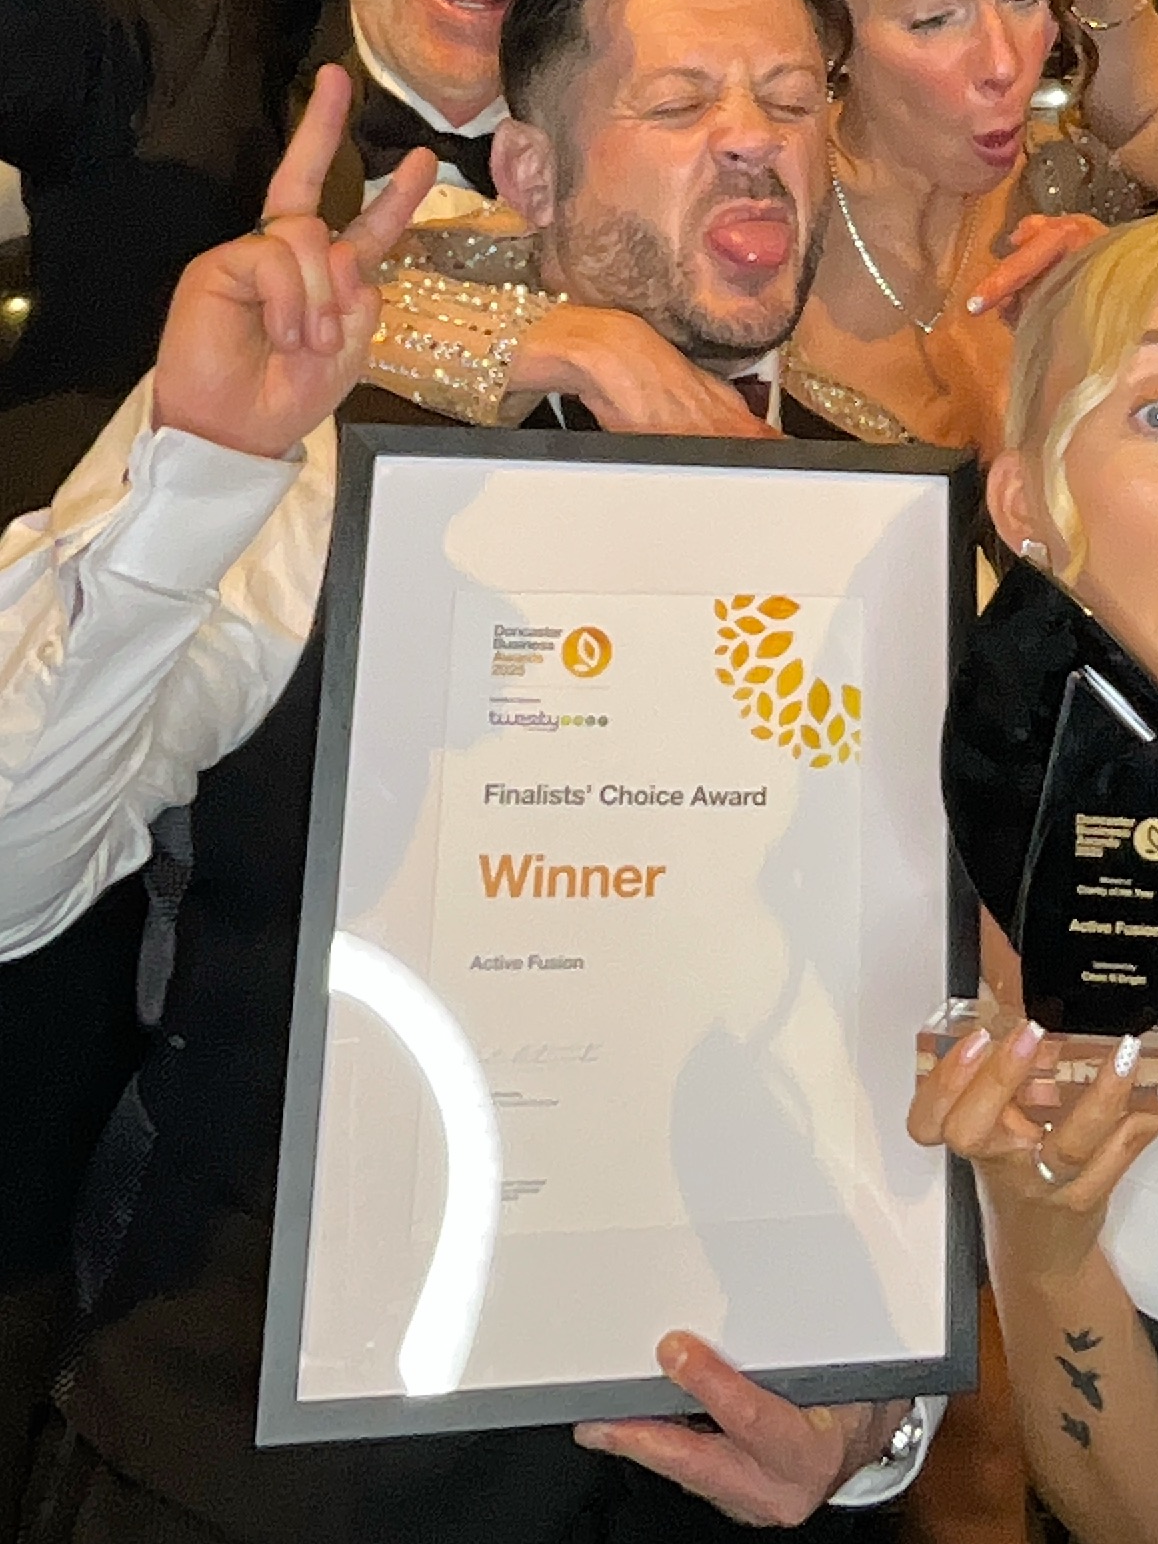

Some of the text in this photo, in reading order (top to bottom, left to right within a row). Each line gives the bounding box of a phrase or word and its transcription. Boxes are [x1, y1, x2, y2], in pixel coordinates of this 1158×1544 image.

[484, 783, 768, 807] Finalists' Choice Award
[479, 853, 667, 898] Winner
[470, 955, 585, 971] Active Fusion
